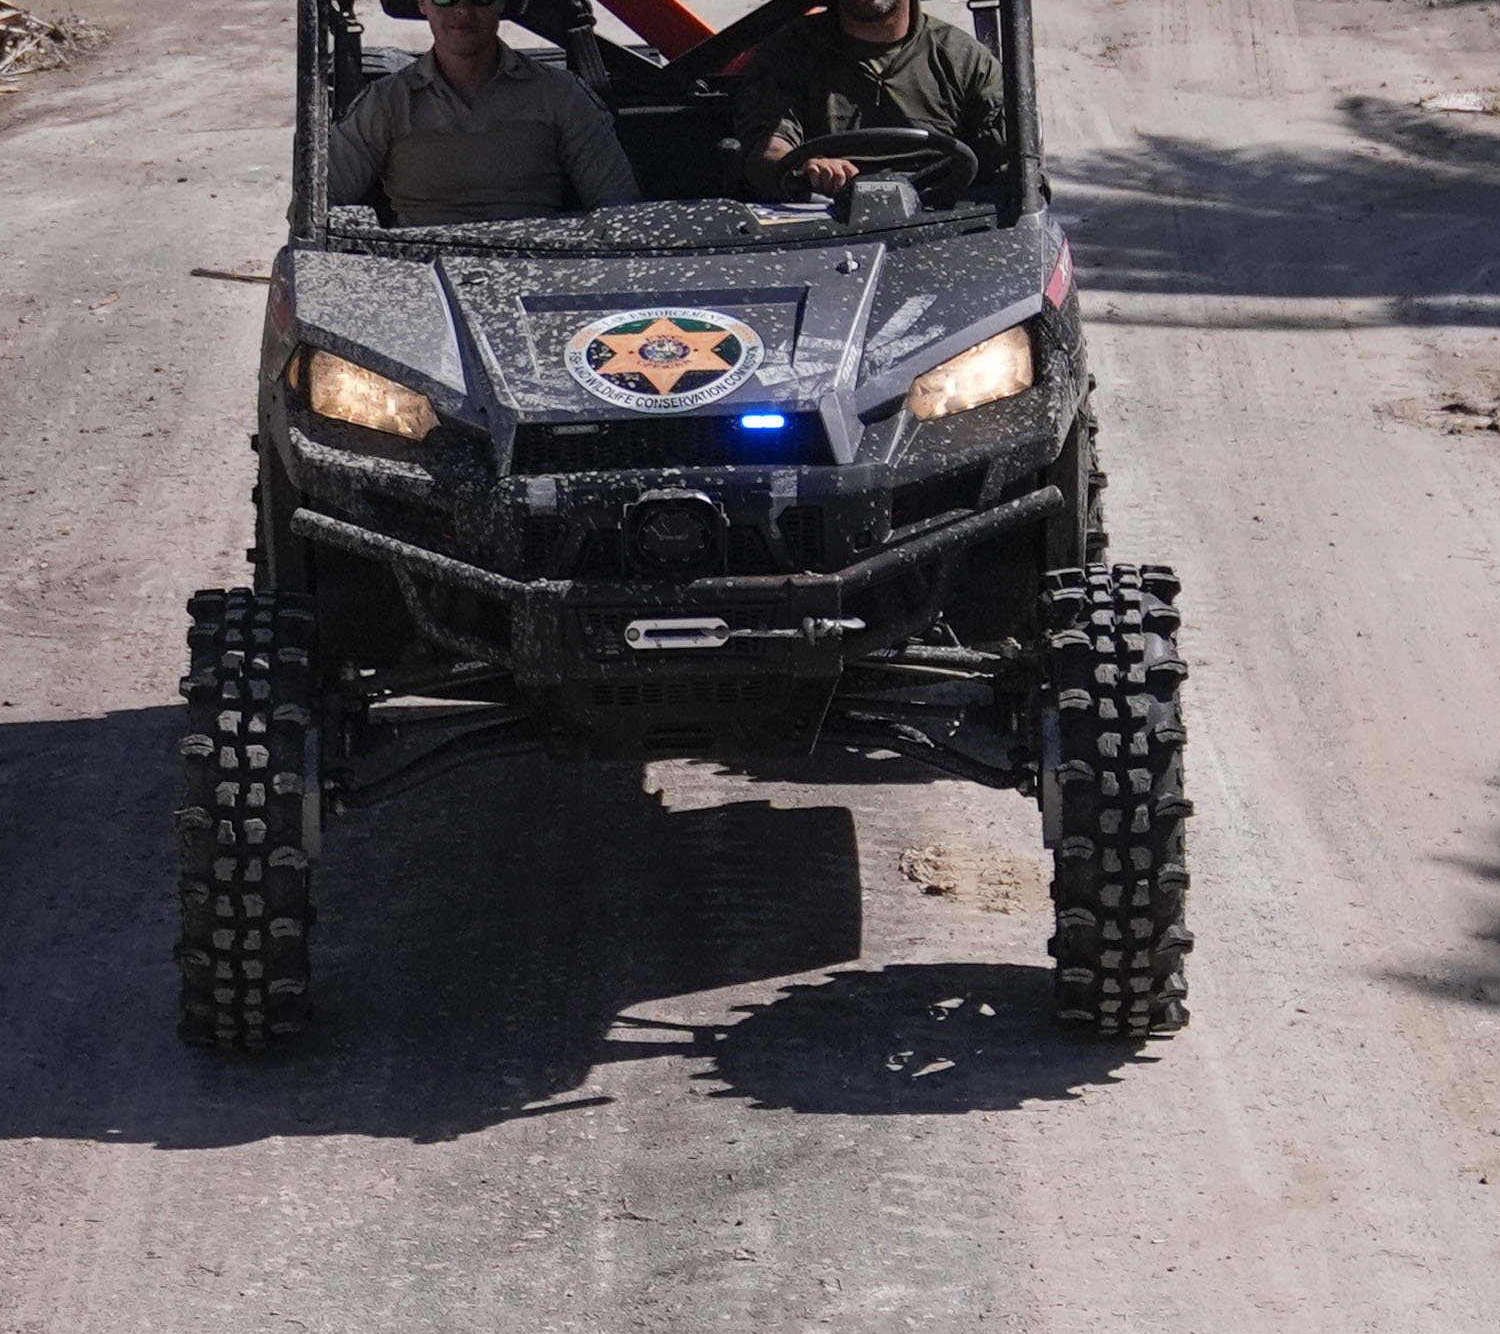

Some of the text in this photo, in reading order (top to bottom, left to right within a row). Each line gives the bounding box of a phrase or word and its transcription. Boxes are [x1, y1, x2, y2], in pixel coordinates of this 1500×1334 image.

[602, 309, 726, 328] LAW ENFORCEMENT
[585, 375, 635, 405] WILDLIFE
[635, 383, 728, 410] CONSERVATION
